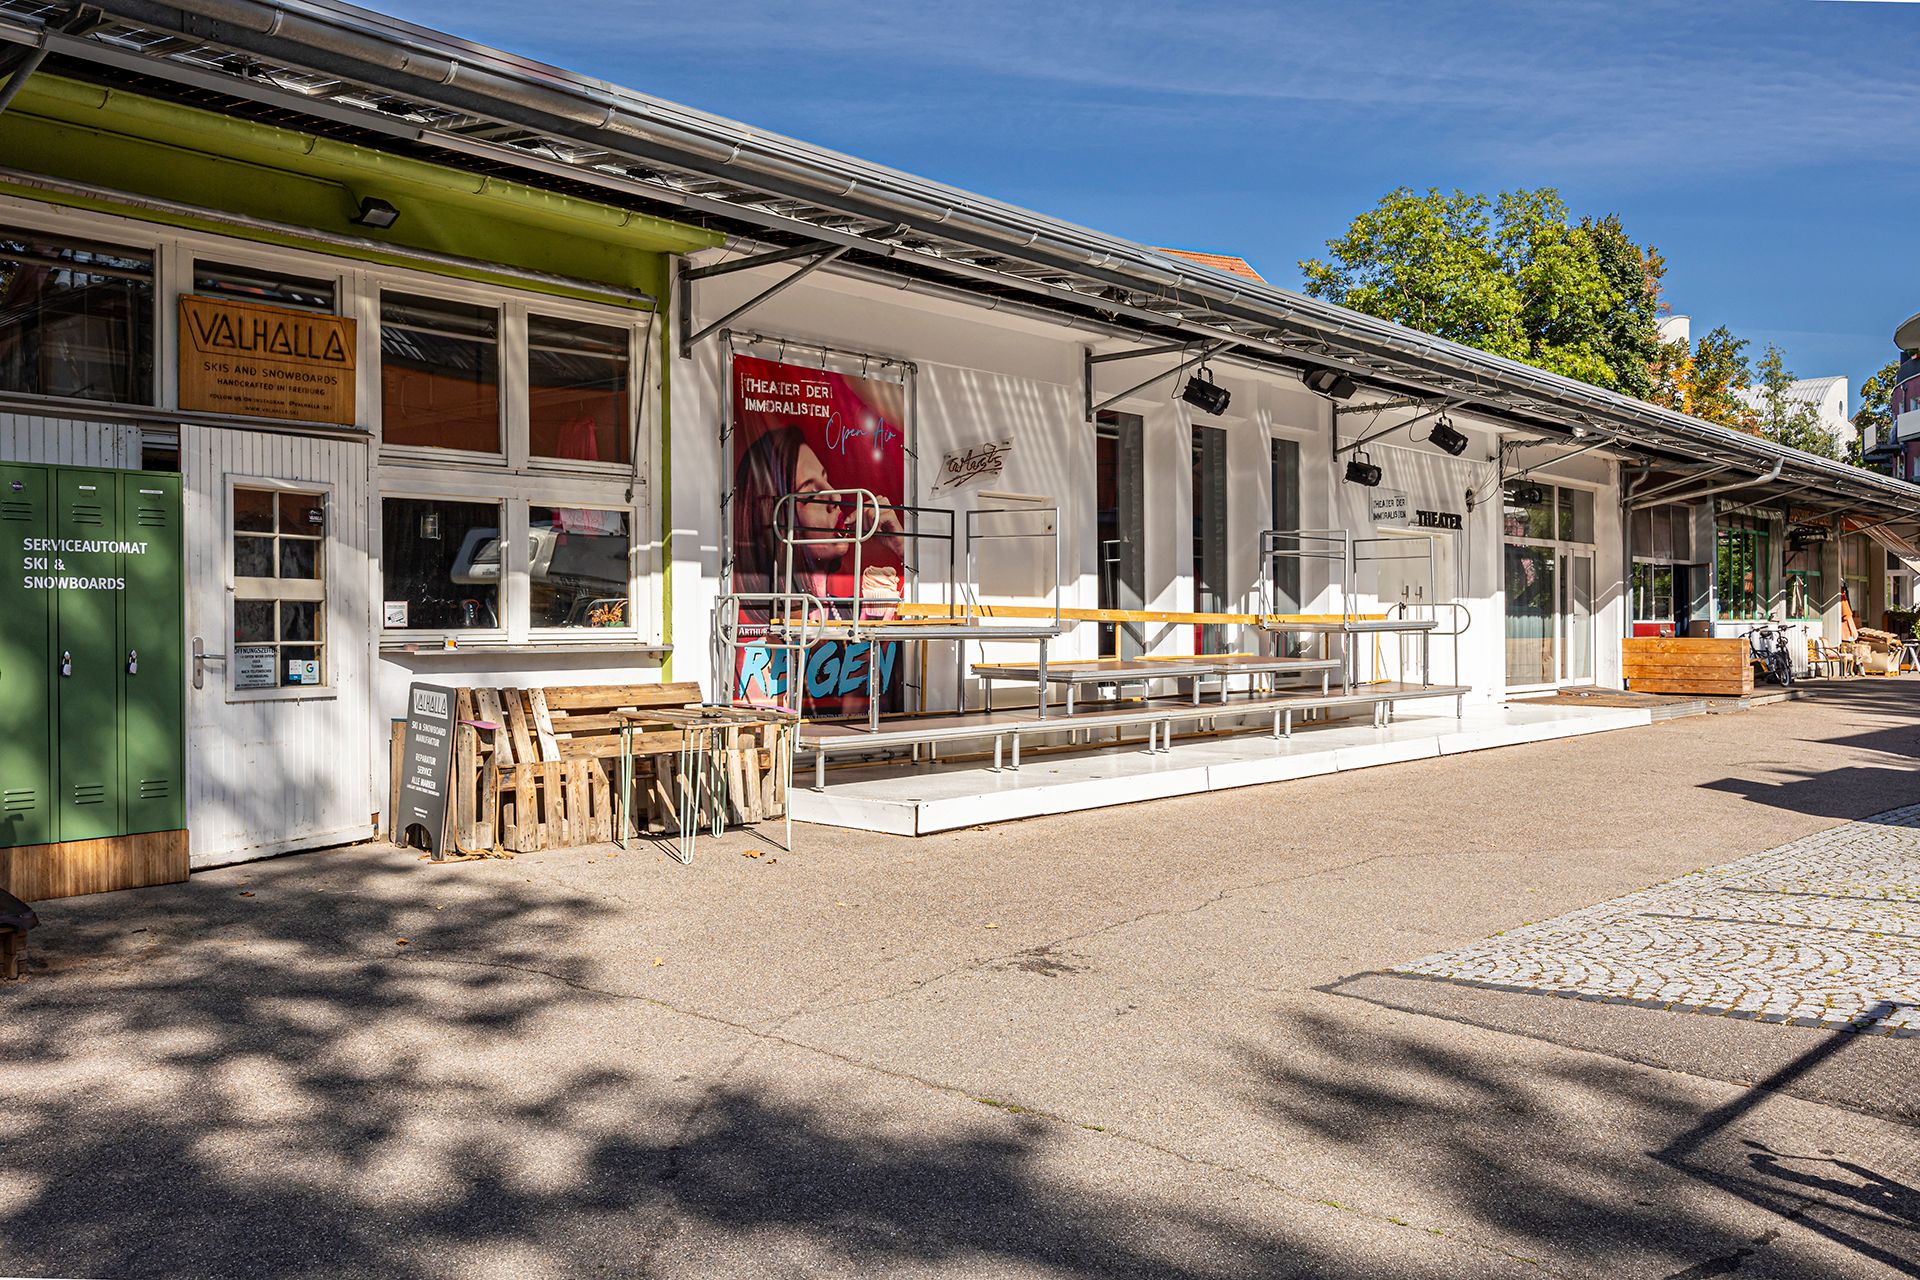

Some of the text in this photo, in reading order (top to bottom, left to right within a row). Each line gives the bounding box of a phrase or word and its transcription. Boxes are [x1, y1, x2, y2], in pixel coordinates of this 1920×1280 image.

[193, 309, 346, 362] VALHALLA
[203, 361, 338, 386] SKIS AND SNOWBOARDS
[217, 378, 274, 391] HANDCRAFTED
[288, 386, 326, 396] FREIBURG
[745, 378, 830, 399] THEATER DER
[744, 398, 830, 418] IMMORALISTEN
[825, 411, 897, 456] Open Air
[1373, 498, 1406, 509] THEATER DER
[1373, 510, 1407, 521] IMMORALISTEN
[1416, 510, 1463, 530] THEATER
[23, 537, 148, 555] SERVICEAUTOMAT
[23, 557, 66, 571] SKI &
[23, 576, 126, 590] SNOWBOARDS
[739, 639, 897, 700] REGEN
